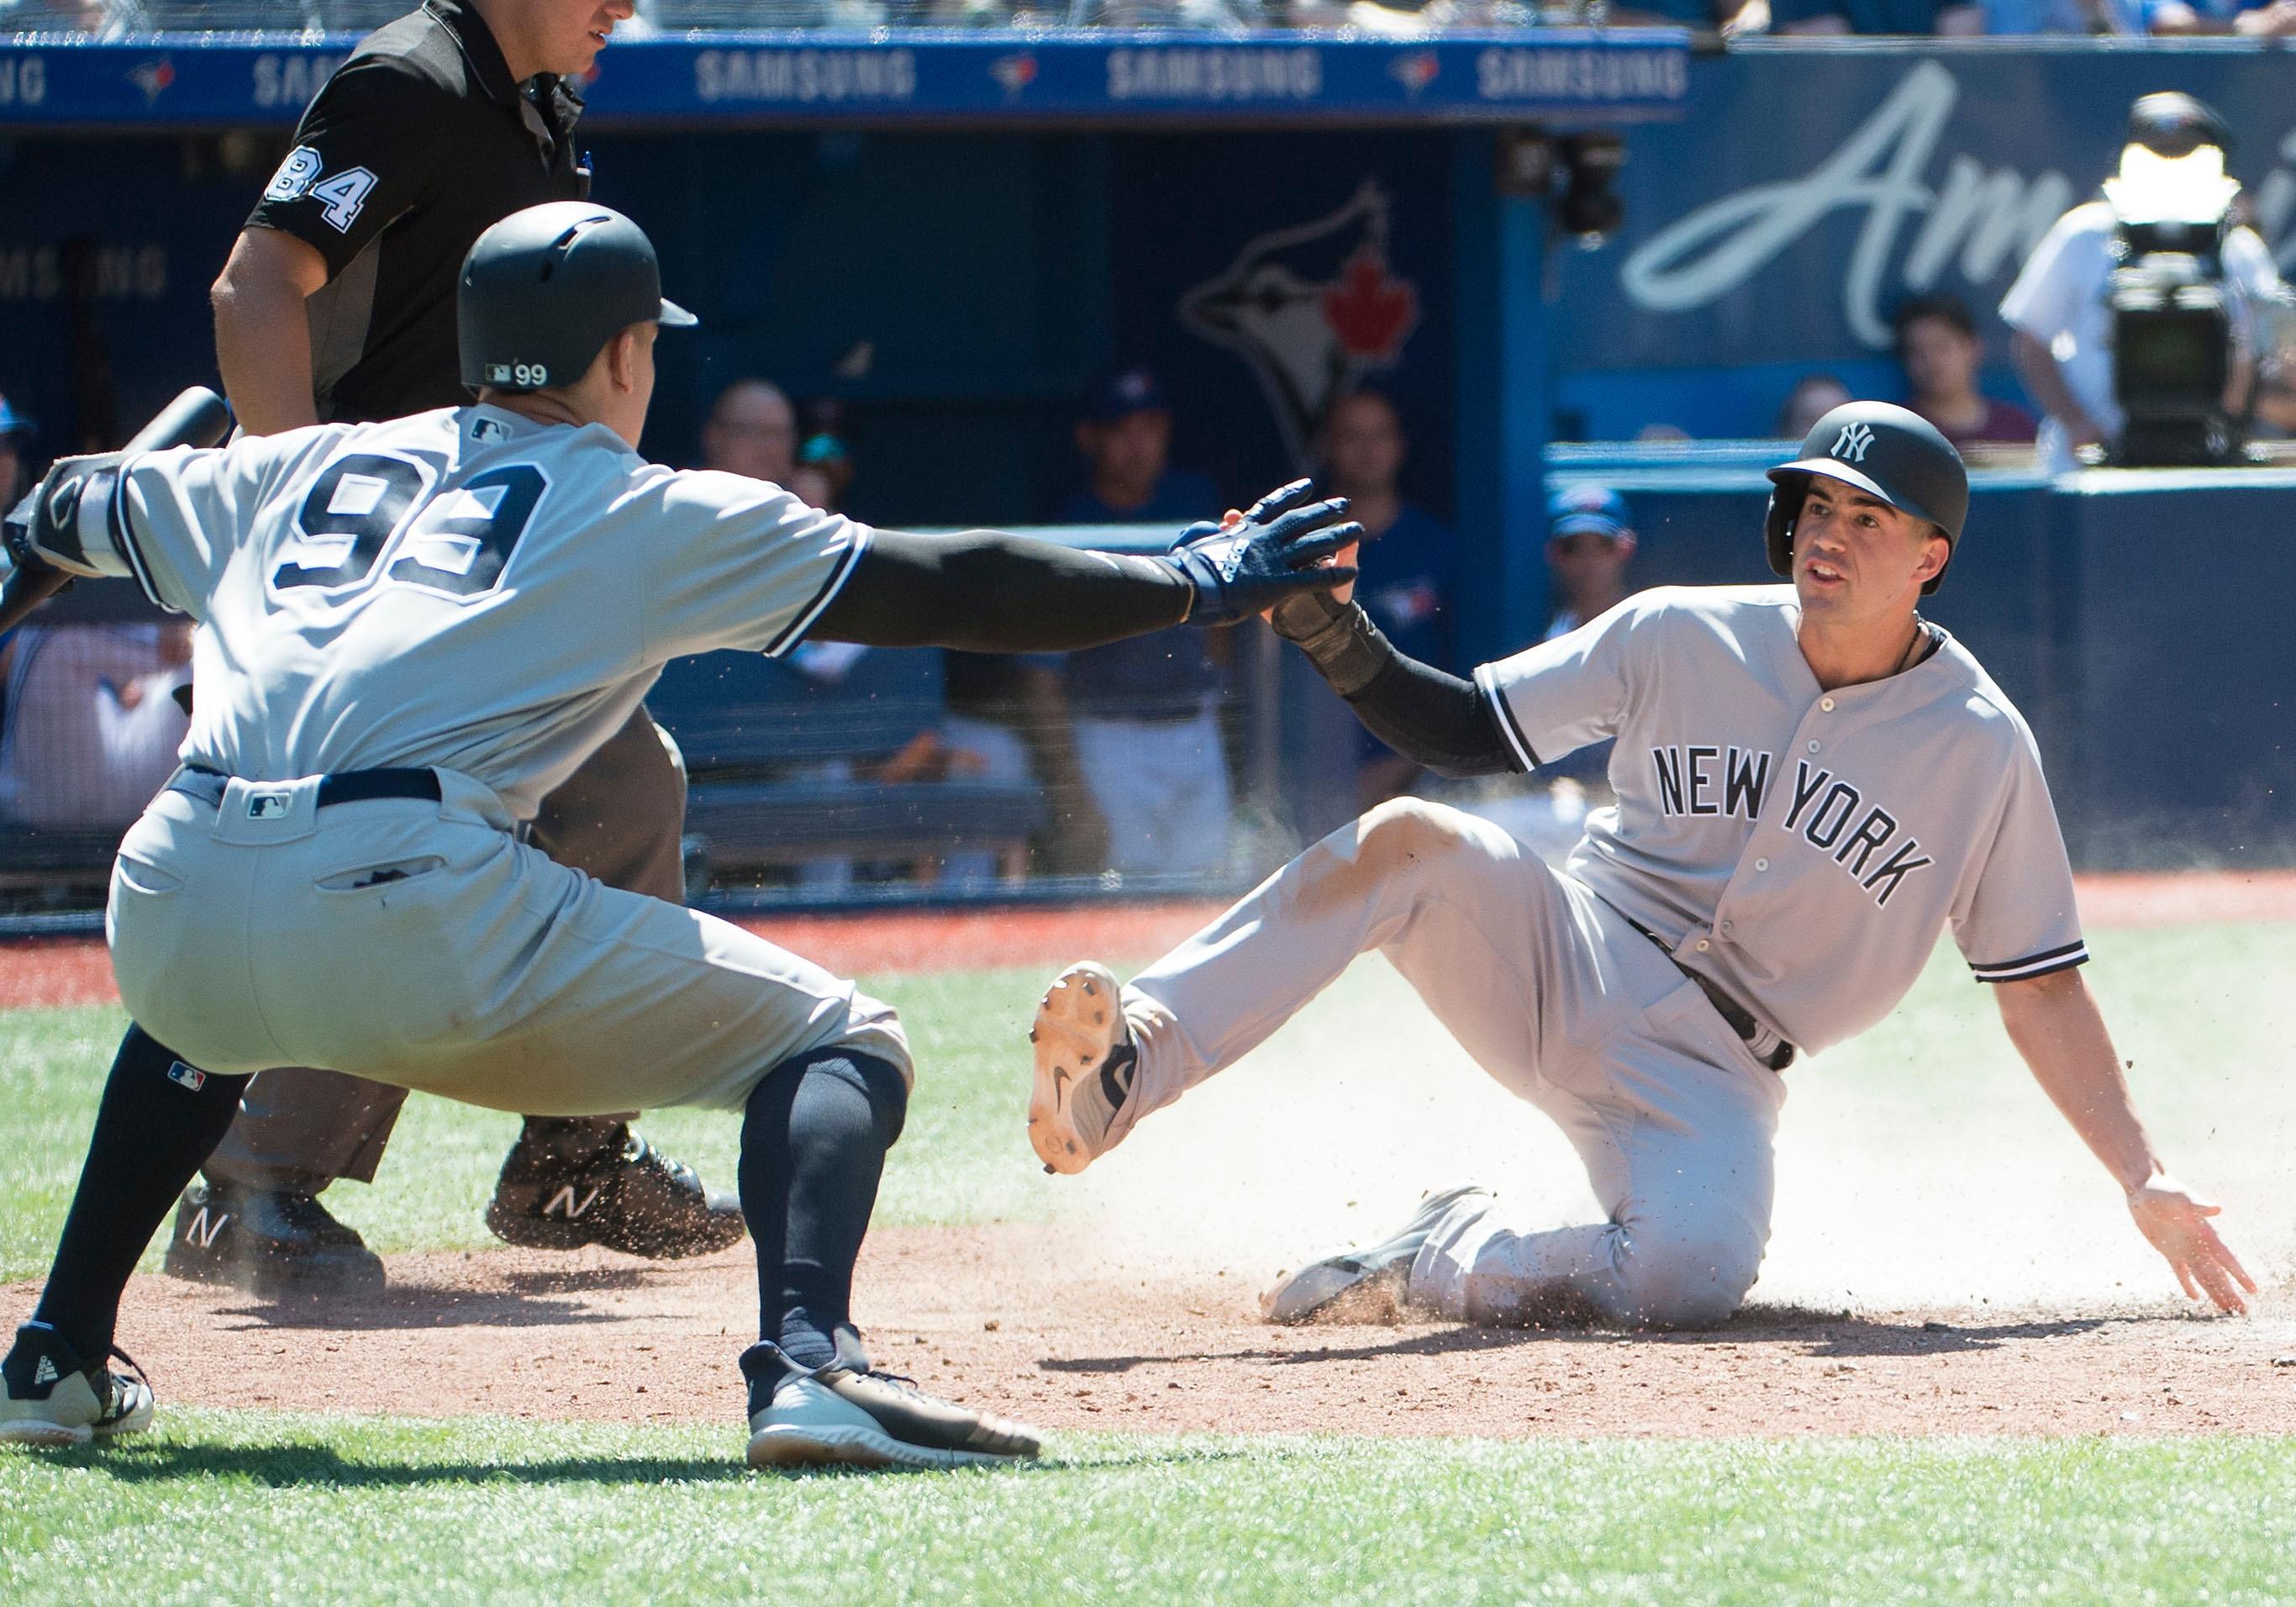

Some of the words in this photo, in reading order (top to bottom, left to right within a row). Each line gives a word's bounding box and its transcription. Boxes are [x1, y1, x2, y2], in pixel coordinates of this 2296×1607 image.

[695, 49, 916, 101] SAMSUNG
[1107, 48, 1323, 100] SAMSUNG
[1477, 49, 1686, 100] SAMSUNG
[264, 145, 379, 234] 84
[515, 364, 547, 385] 99
[1830, 421, 1876, 462] NY
[266, 450, 553, 604] 99
[1651, 745, 1773, 820] NEW
[1782, 757, 1935, 911] YORK
